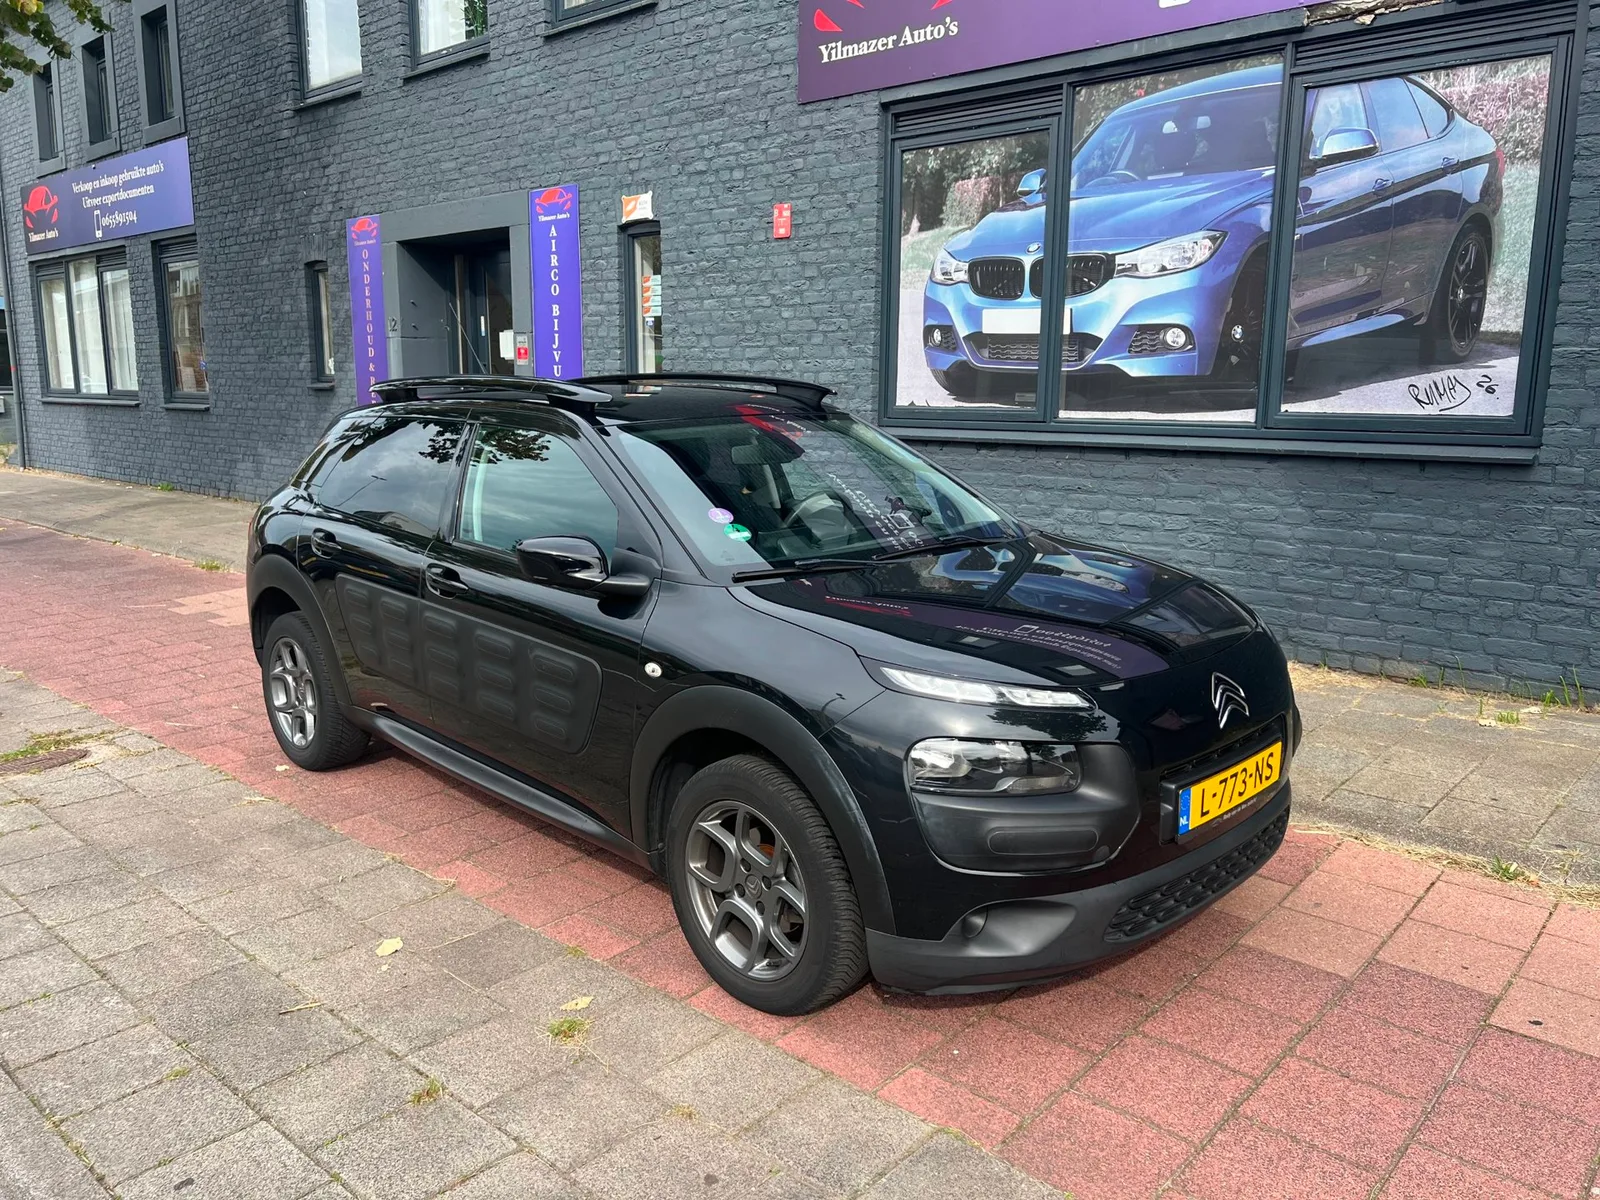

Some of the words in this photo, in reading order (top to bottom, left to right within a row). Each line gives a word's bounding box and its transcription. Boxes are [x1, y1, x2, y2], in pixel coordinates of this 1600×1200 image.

[818, 34, 898, 63] Yilmazer
[898, 16, 959, 47] Auto's
[72, 181, 93, 194] Verkoop
[94, 180, 100, 188] en
[100, 174, 119, 187] inkoop
[119, 165, 146, 186] gebruikte
[146, 160, 165, 176] auto's
[82, 196, 102, 209] Uitvoer
[102, 184, 155, 207] exportdocumenten
[101, 210, 138, 228] 0655891504
[549, 224, 560, 296] AIRCO
[362, 248, 375, 358] ONDERHOUD
[368, 362, 375, 372] &
[1200, 751, 1275, 819] L-773-NS
[1179, 815, 1189, 827] NL
